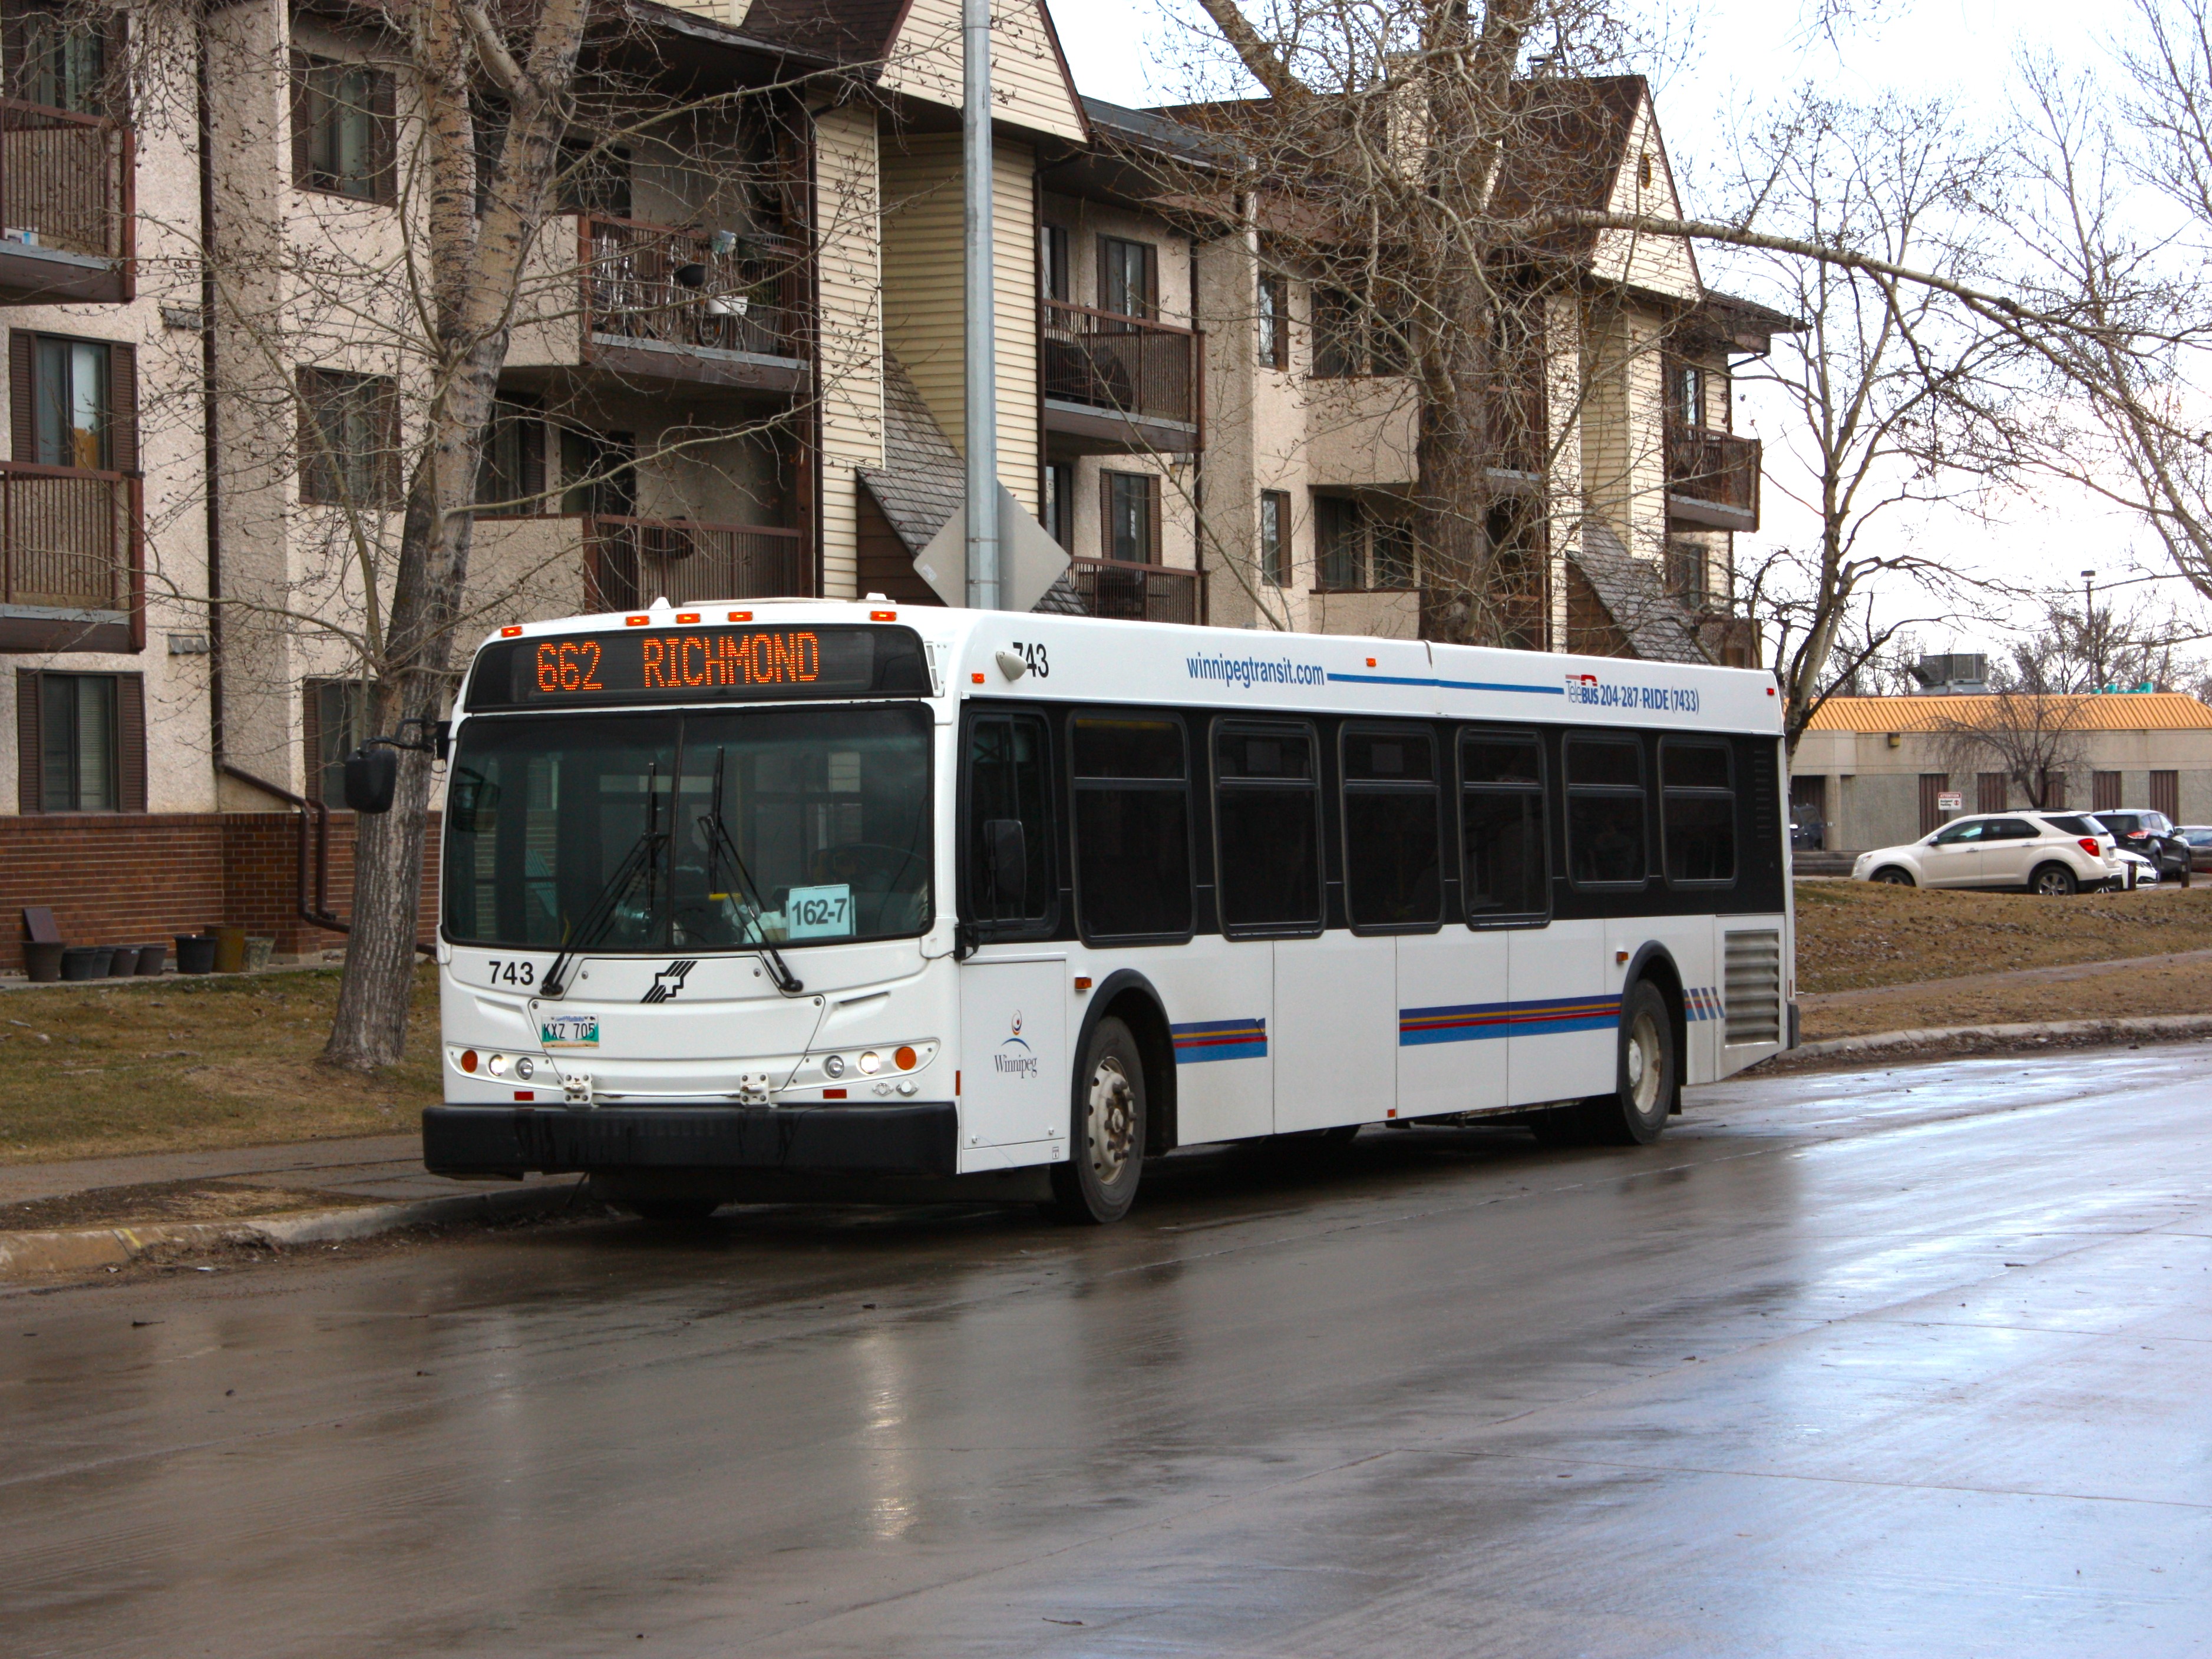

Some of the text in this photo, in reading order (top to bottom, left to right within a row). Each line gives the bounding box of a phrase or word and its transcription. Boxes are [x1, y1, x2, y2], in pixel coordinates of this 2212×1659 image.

[537, 632, 819, 692] 662 RICHMOND
[1186, 652, 1325, 689] winnipegtransit.com
[1670, 685, 1699, 715] (7433)
[792, 898, 847, 926] 162-7
[488, 961, 534, 986] 743
[543, 1023, 595, 1039] KXZ 705
[994, 1054, 1038, 1079] Winnipeg
